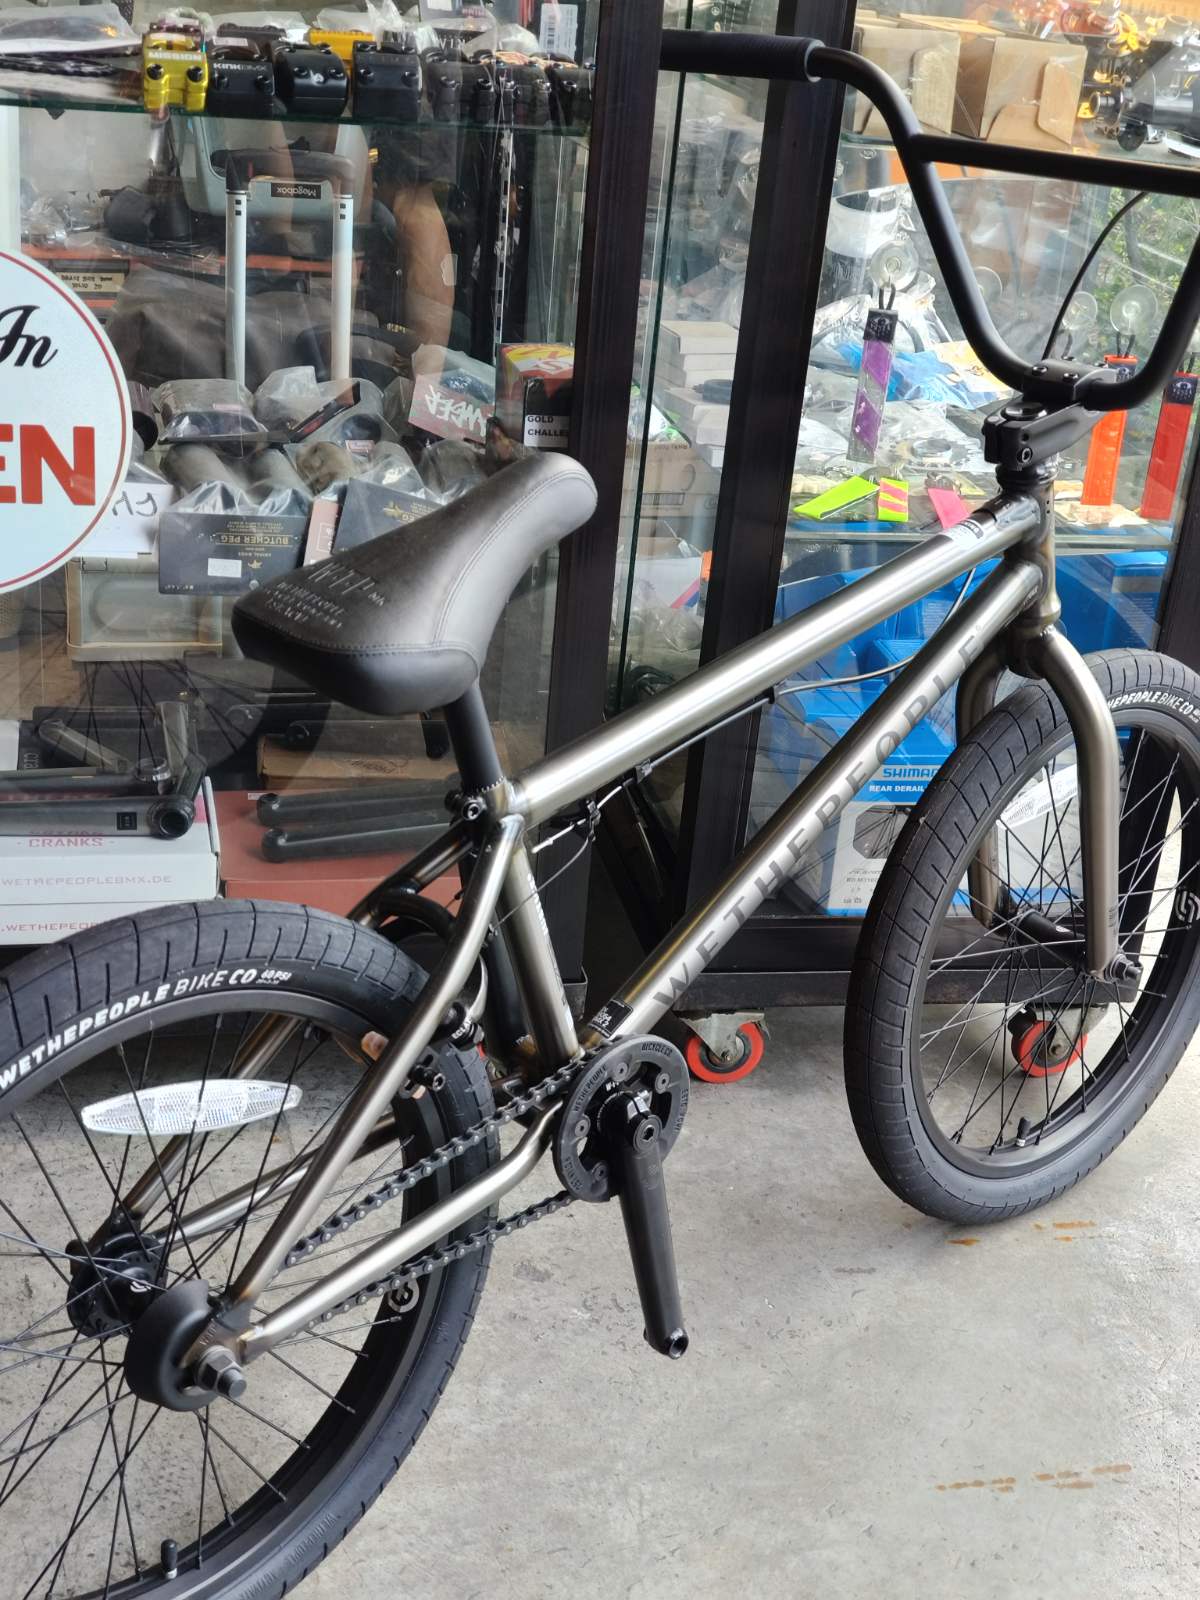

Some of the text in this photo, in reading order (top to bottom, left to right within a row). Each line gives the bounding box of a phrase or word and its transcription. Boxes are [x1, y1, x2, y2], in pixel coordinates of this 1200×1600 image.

[276, 186, 317, 198] Megabox
[527, 415, 554, 424] GOLD
[0, 424, 96, 506] N
[220, 535, 289, 545] BUTCHER PEG
[1159, 691, 1184, 710] BIKE
[1179, 701, 1194, 715] CO
[869, 784, 893, 792] REAR
[28, 836, 105, 848] CRANKS
[0, 983, 171, 1090] WETHEPEOPLE
[172, 968, 229, 997] BIKE
[228, 967, 258, 986] CO
